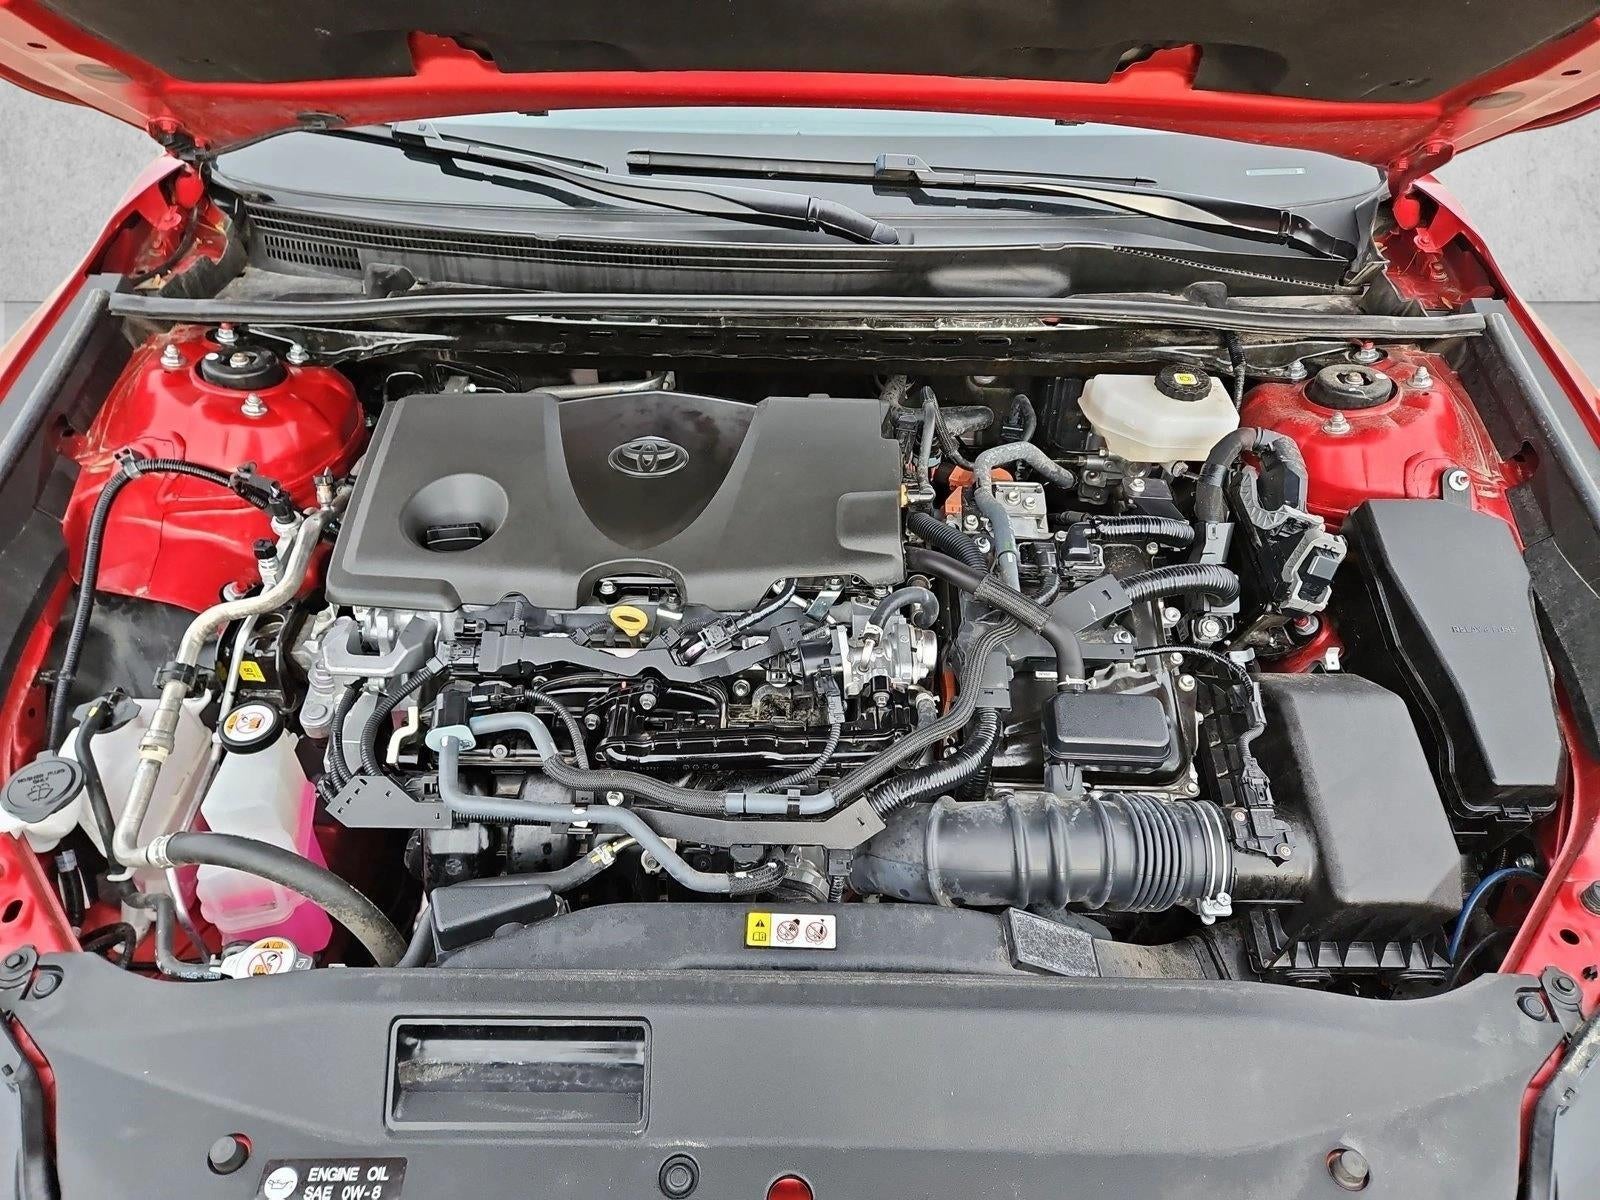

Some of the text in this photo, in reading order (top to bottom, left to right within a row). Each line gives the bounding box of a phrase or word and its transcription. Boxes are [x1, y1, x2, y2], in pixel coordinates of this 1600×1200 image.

[308, 1166, 389, 1182] ENGINE OIL
[303, 1185, 381, 1200] SAE 0W-8
